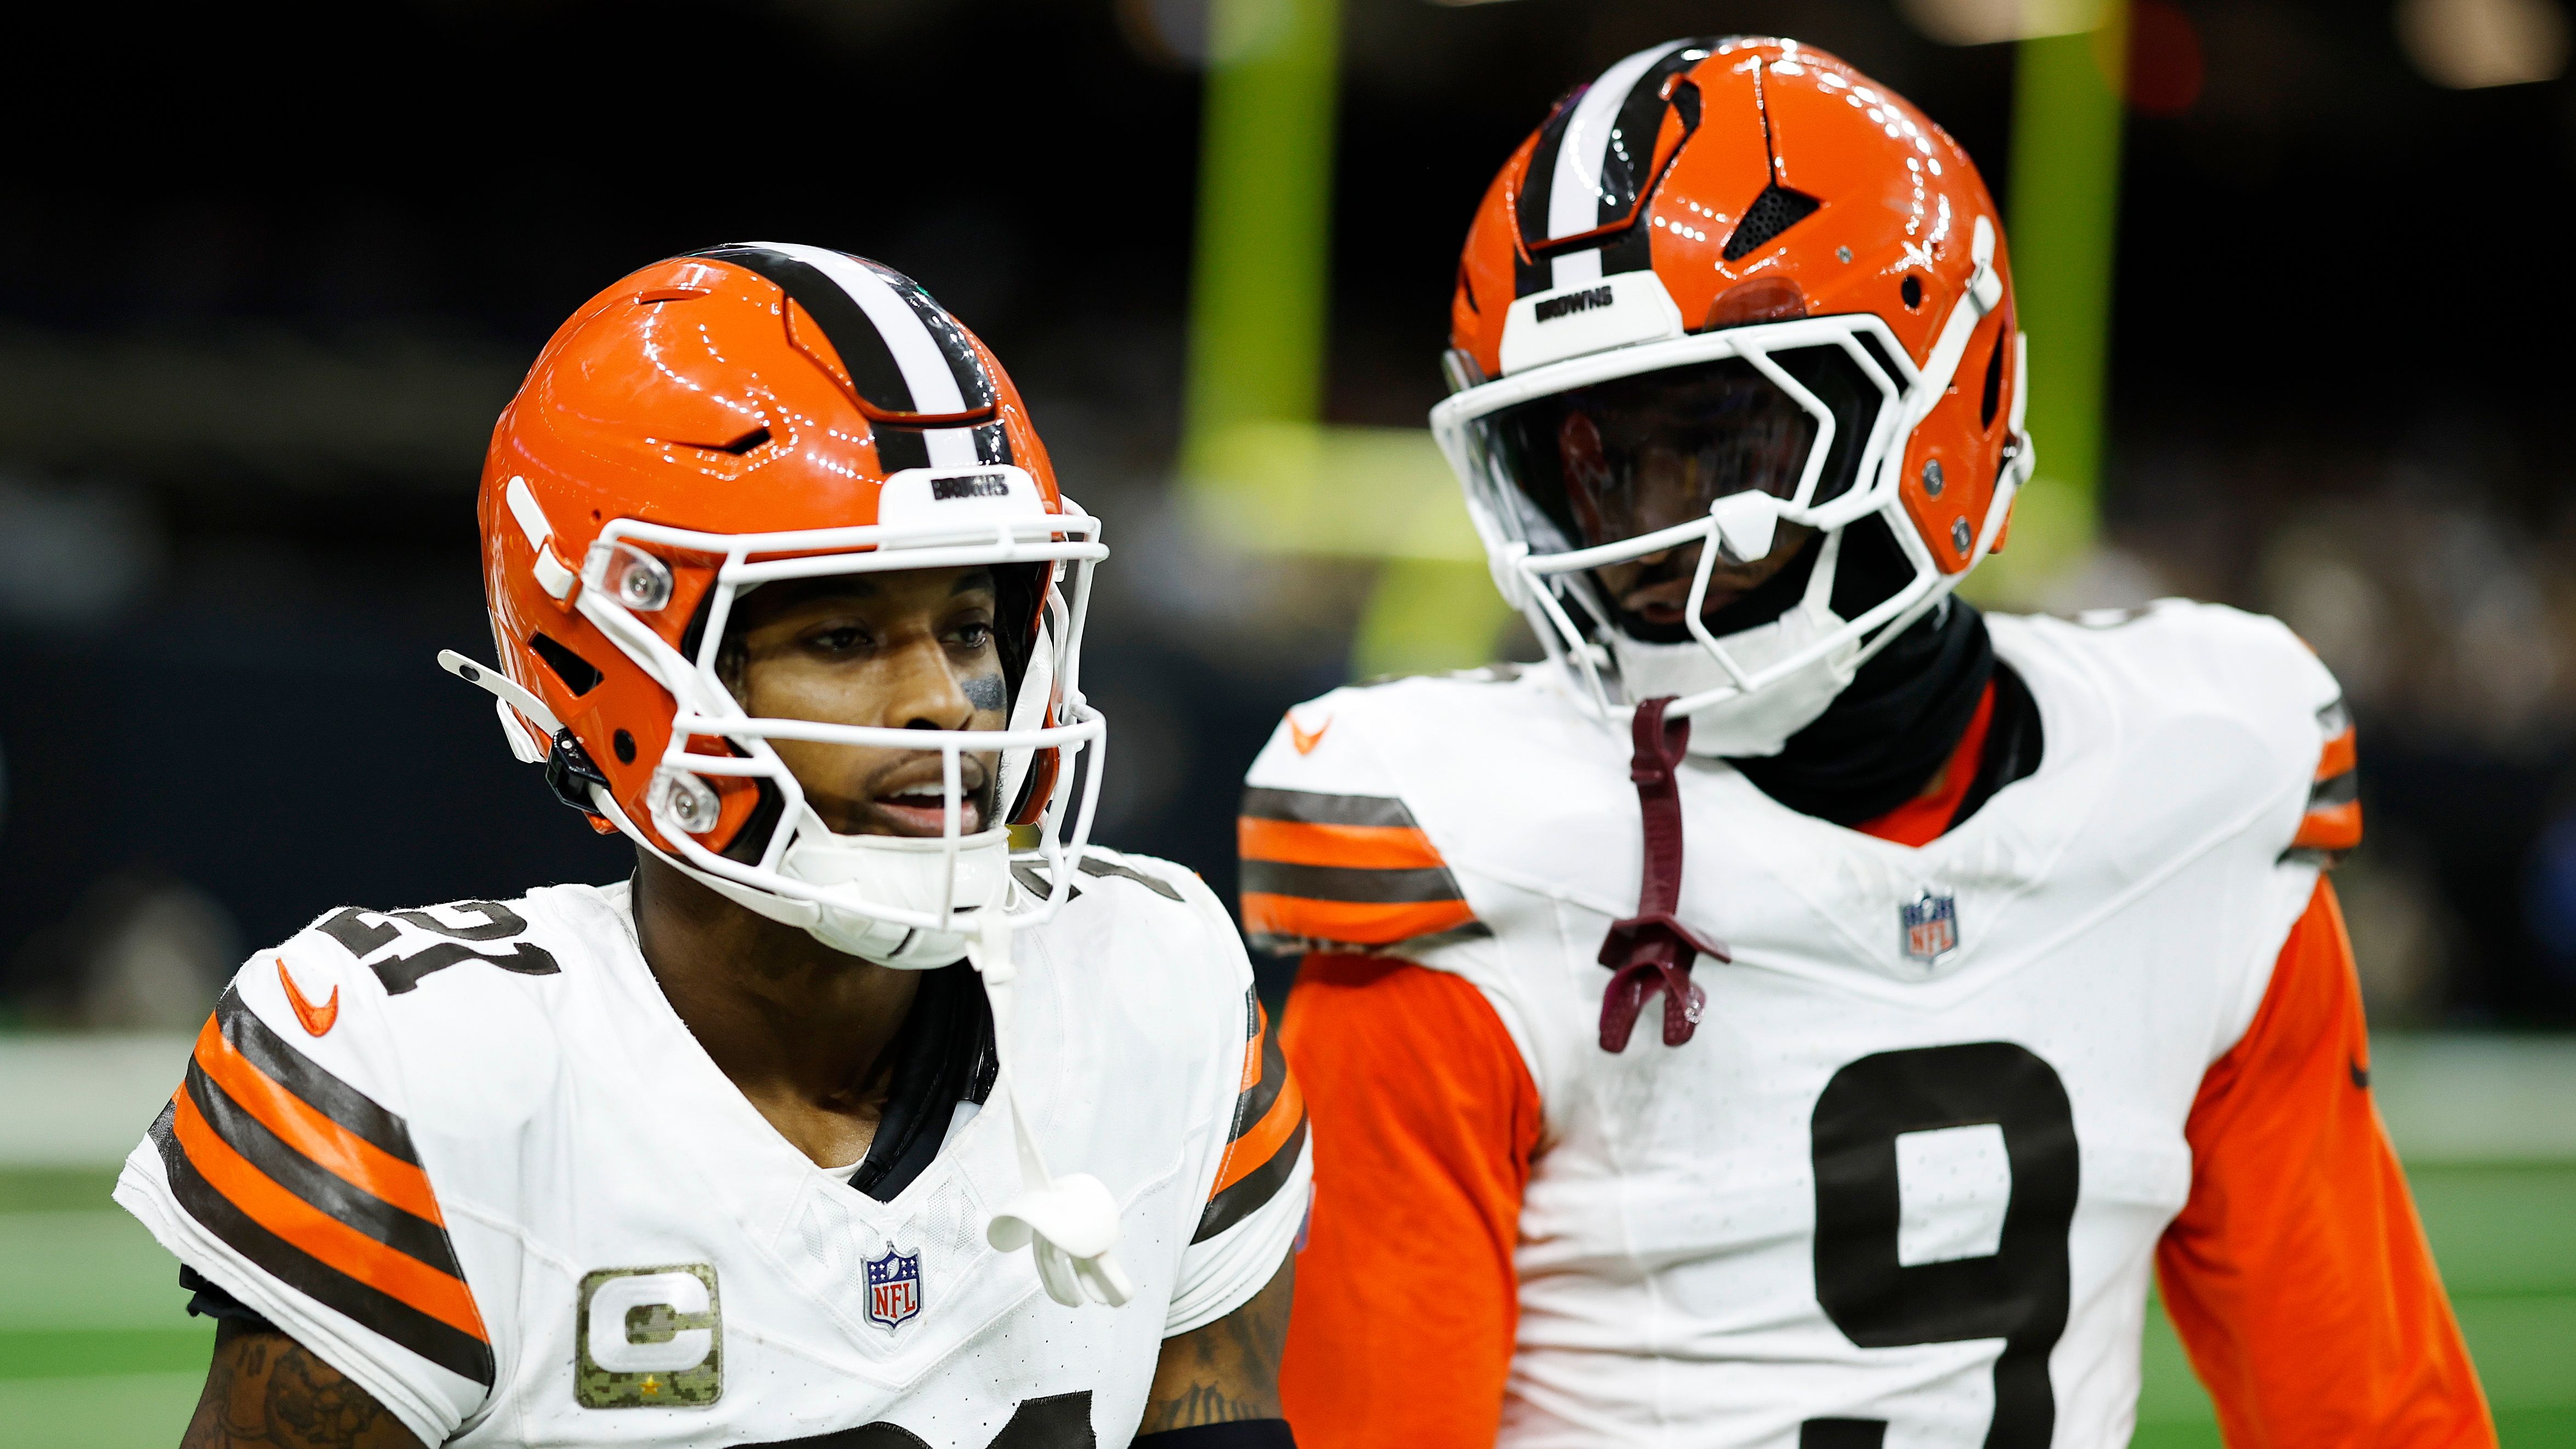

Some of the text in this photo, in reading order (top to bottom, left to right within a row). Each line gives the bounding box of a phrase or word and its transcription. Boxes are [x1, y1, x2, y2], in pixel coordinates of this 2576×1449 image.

[1909, 919, 1954, 957] NFL
[1799, 1041, 2080, 1449] 9
[588, 1272, 712, 1373] C
[875, 1283, 915, 1319] NFL
